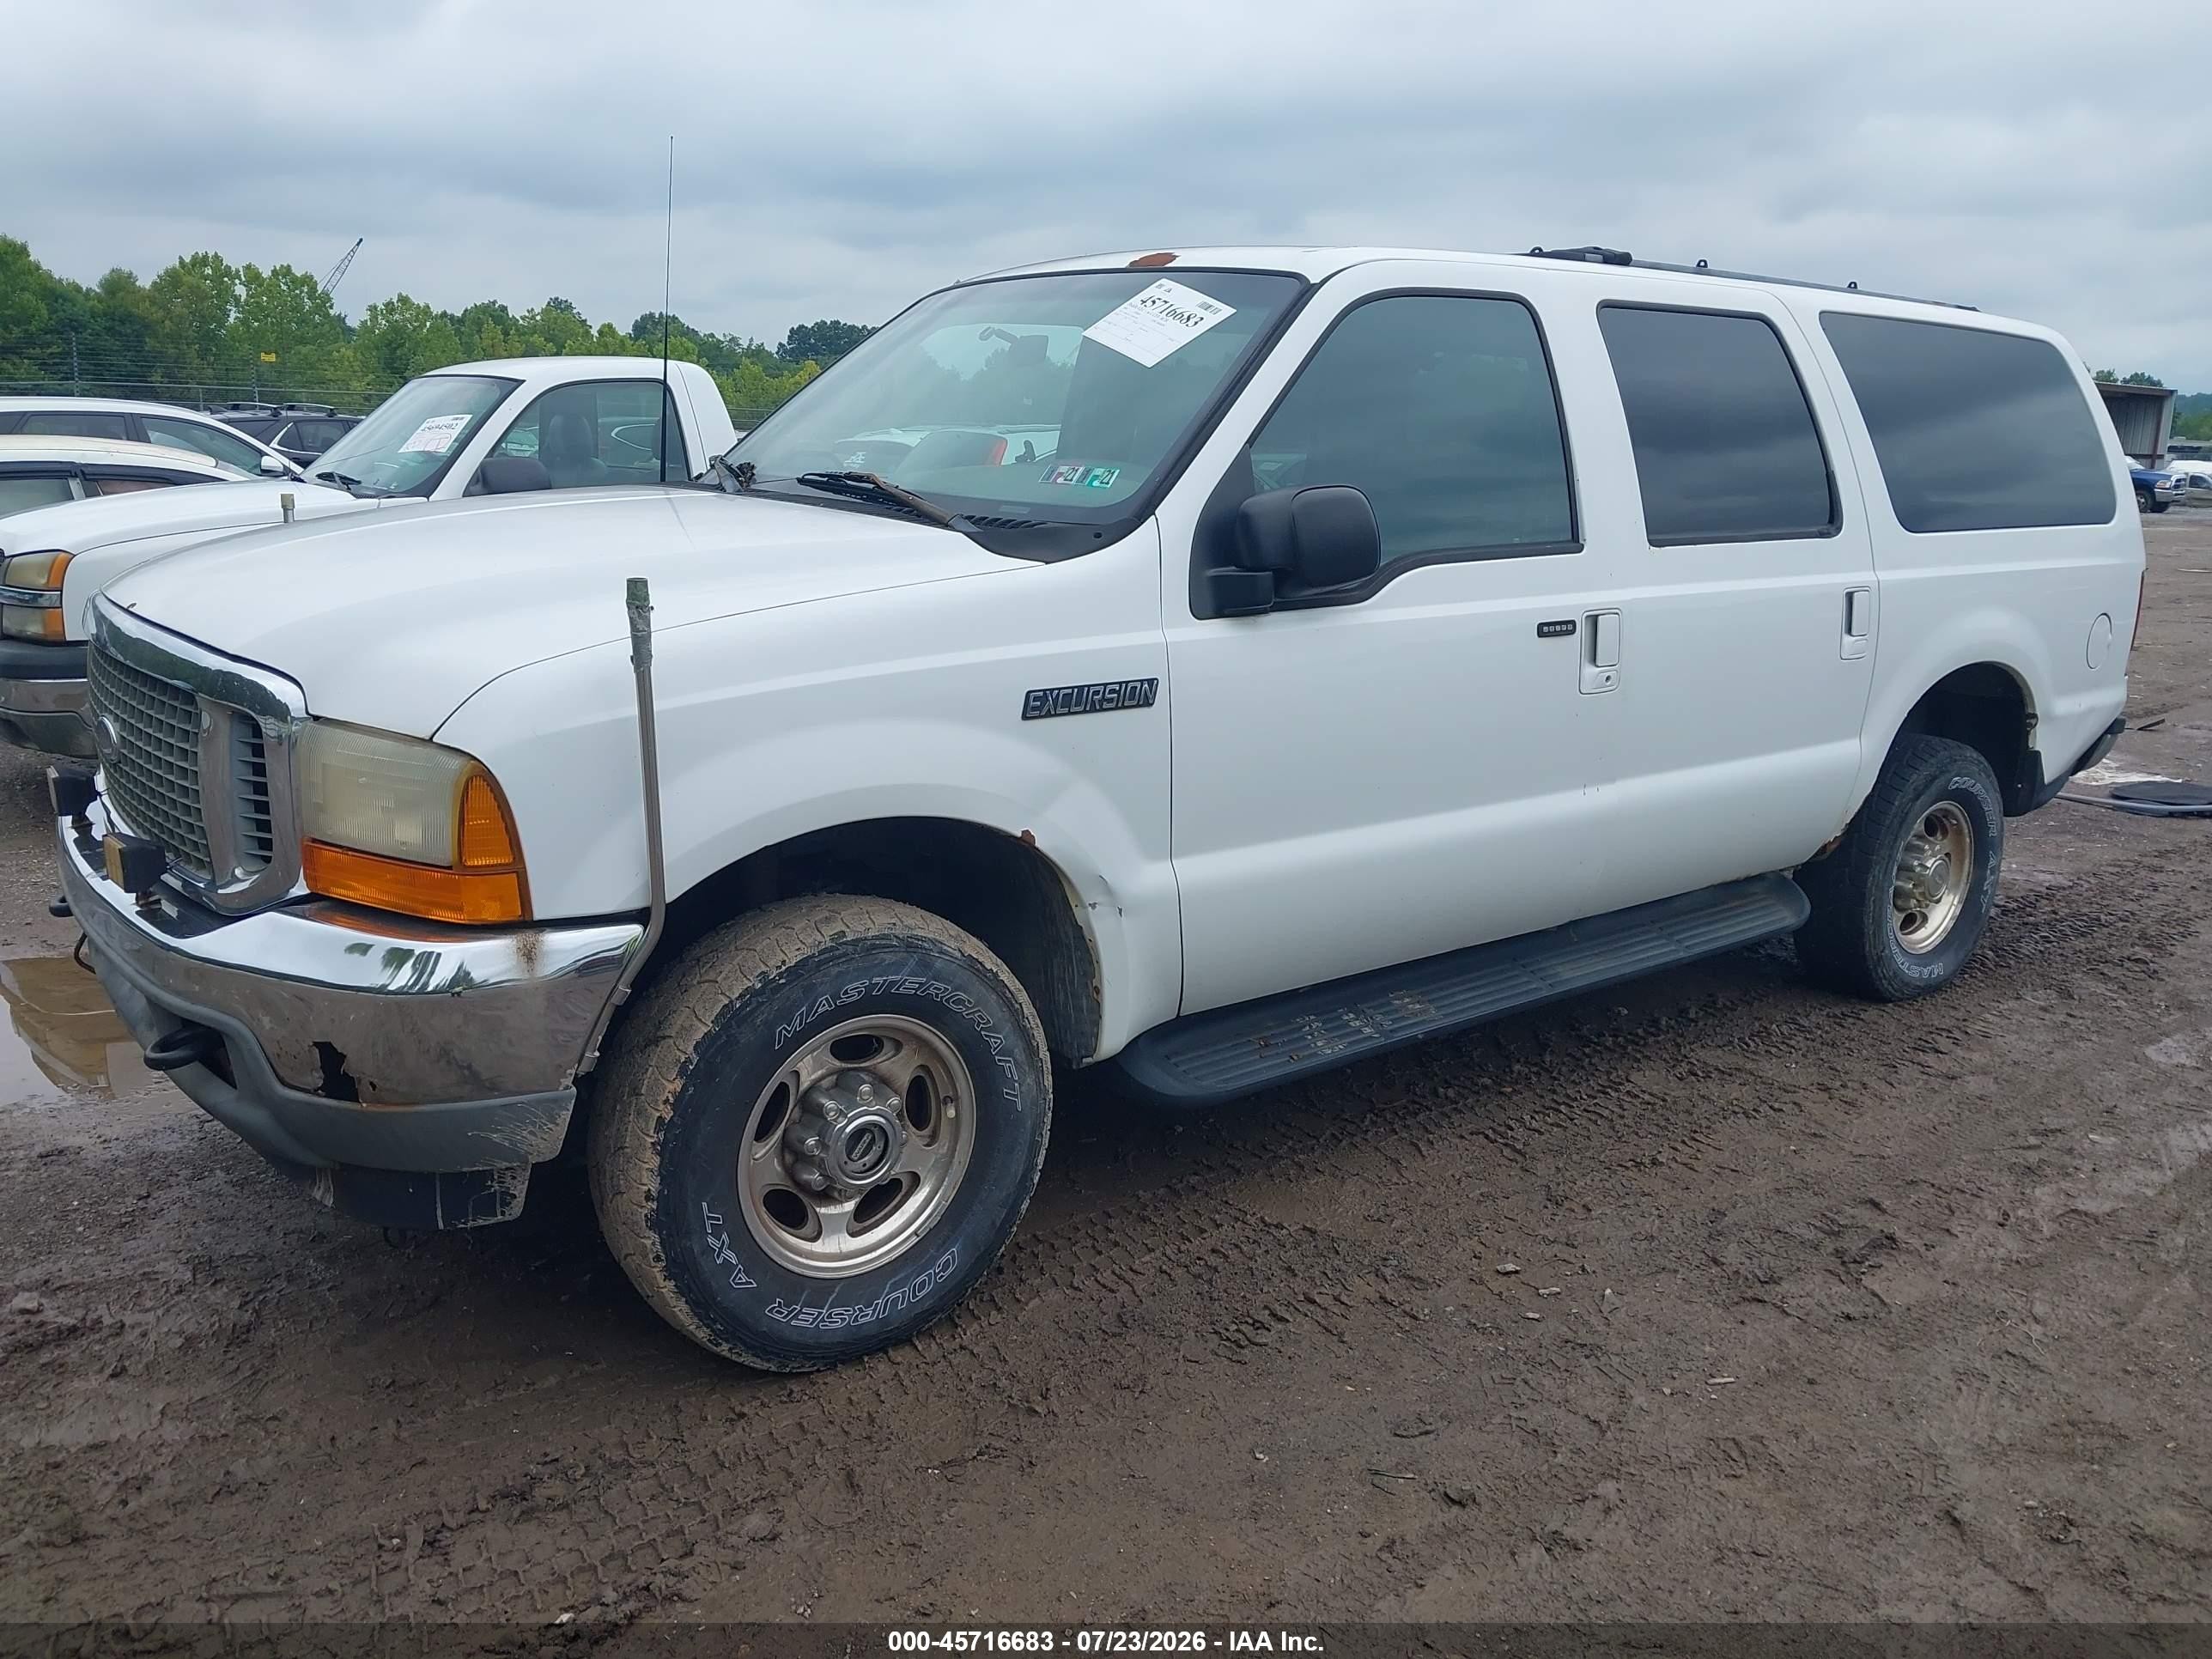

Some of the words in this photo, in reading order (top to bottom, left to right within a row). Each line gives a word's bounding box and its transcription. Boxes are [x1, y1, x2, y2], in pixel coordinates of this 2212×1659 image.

[1139, 295, 1205, 328] 45716683
[1063, 466, 1079, 482] 21
[1099, 469, 1115, 485] 21
[1025, 679, 1158, 718] EXCURSION
[1948, 776, 1999, 837] COURSER
[775, 975, 1022, 1111] MASTERCRAFT
[702, 1202, 757, 1289] AXT
[765, 1246, 959, 1330] COURSER
